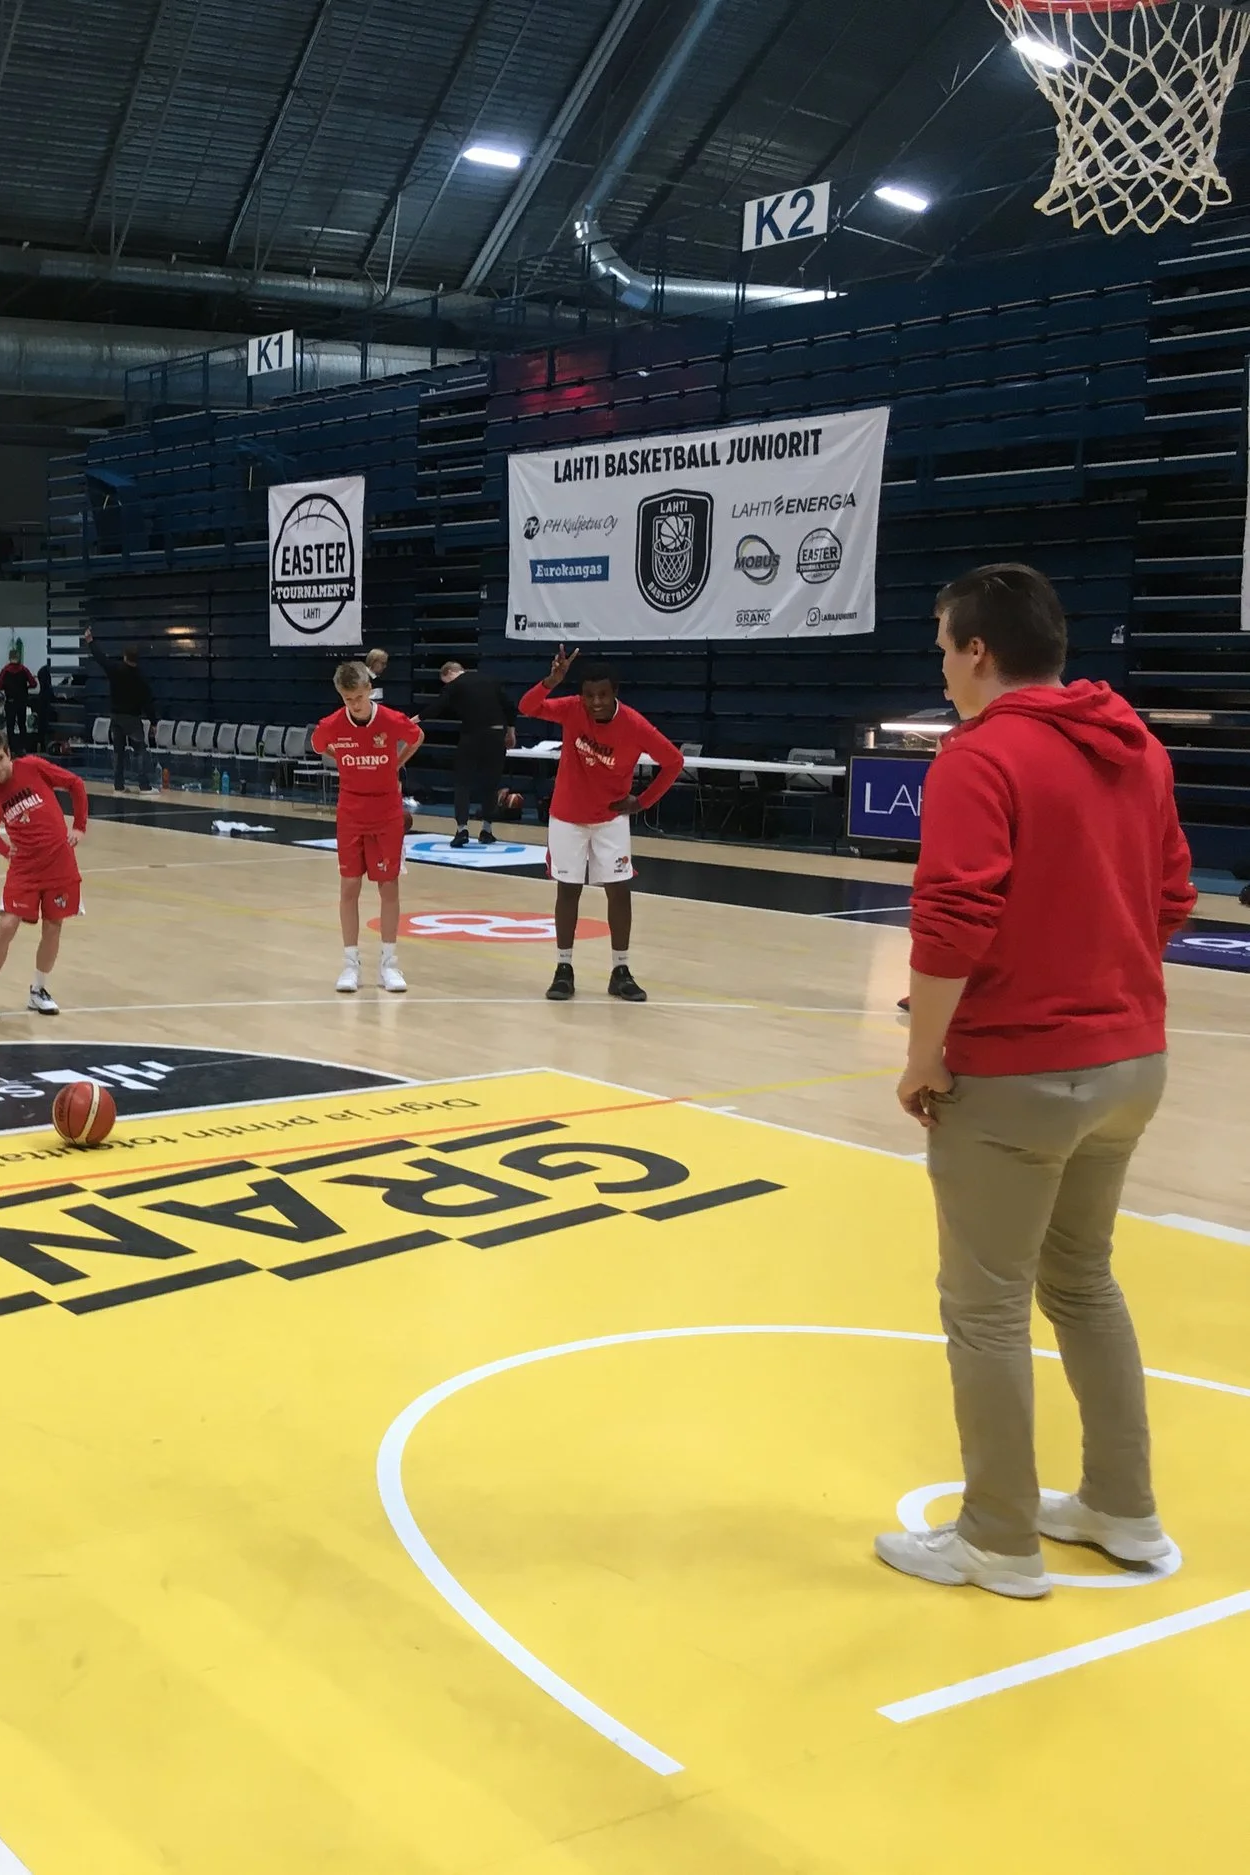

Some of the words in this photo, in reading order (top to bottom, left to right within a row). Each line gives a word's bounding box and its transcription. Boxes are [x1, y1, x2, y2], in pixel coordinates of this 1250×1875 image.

[755, 188, 816, 247] K2
[257, 335, 285, 373] K1
[554, 455, 599, 483] LAHTI
[605, 441, 721, 478] BASKETBALL
[726, 428, 822, 465] JUNIORIT
[660, 501, 688, 514] LAHTI
[732, 501, 771, 518] LAHTI
[785, 493, 856, 514] ENERGIA
[543, 518, 562, 534] PH
[562, 515, 602, 538] Kuljetus
[603, 515, 618, 536] Oy
[281, 542, 346, 576] EASTER
[734, 554, 781, 571] MOBUS
[802, 546, 838, 561] EASTER
[535, 564, 602, 578] Eurokangas
[276, 583, 350, 600] TOURNAMENT
[647, 581, 696, 603] BASKETBALL
[303, 607, 321, 619] LAHTI
[735, 612, 771, 623] GRANO
[356, 755, 389, 766] INNO
[325, 1108, 372, 1121] ja
[369, 1097, 481, 1116] Digin
[183, 1115, 318, 1139] printin
